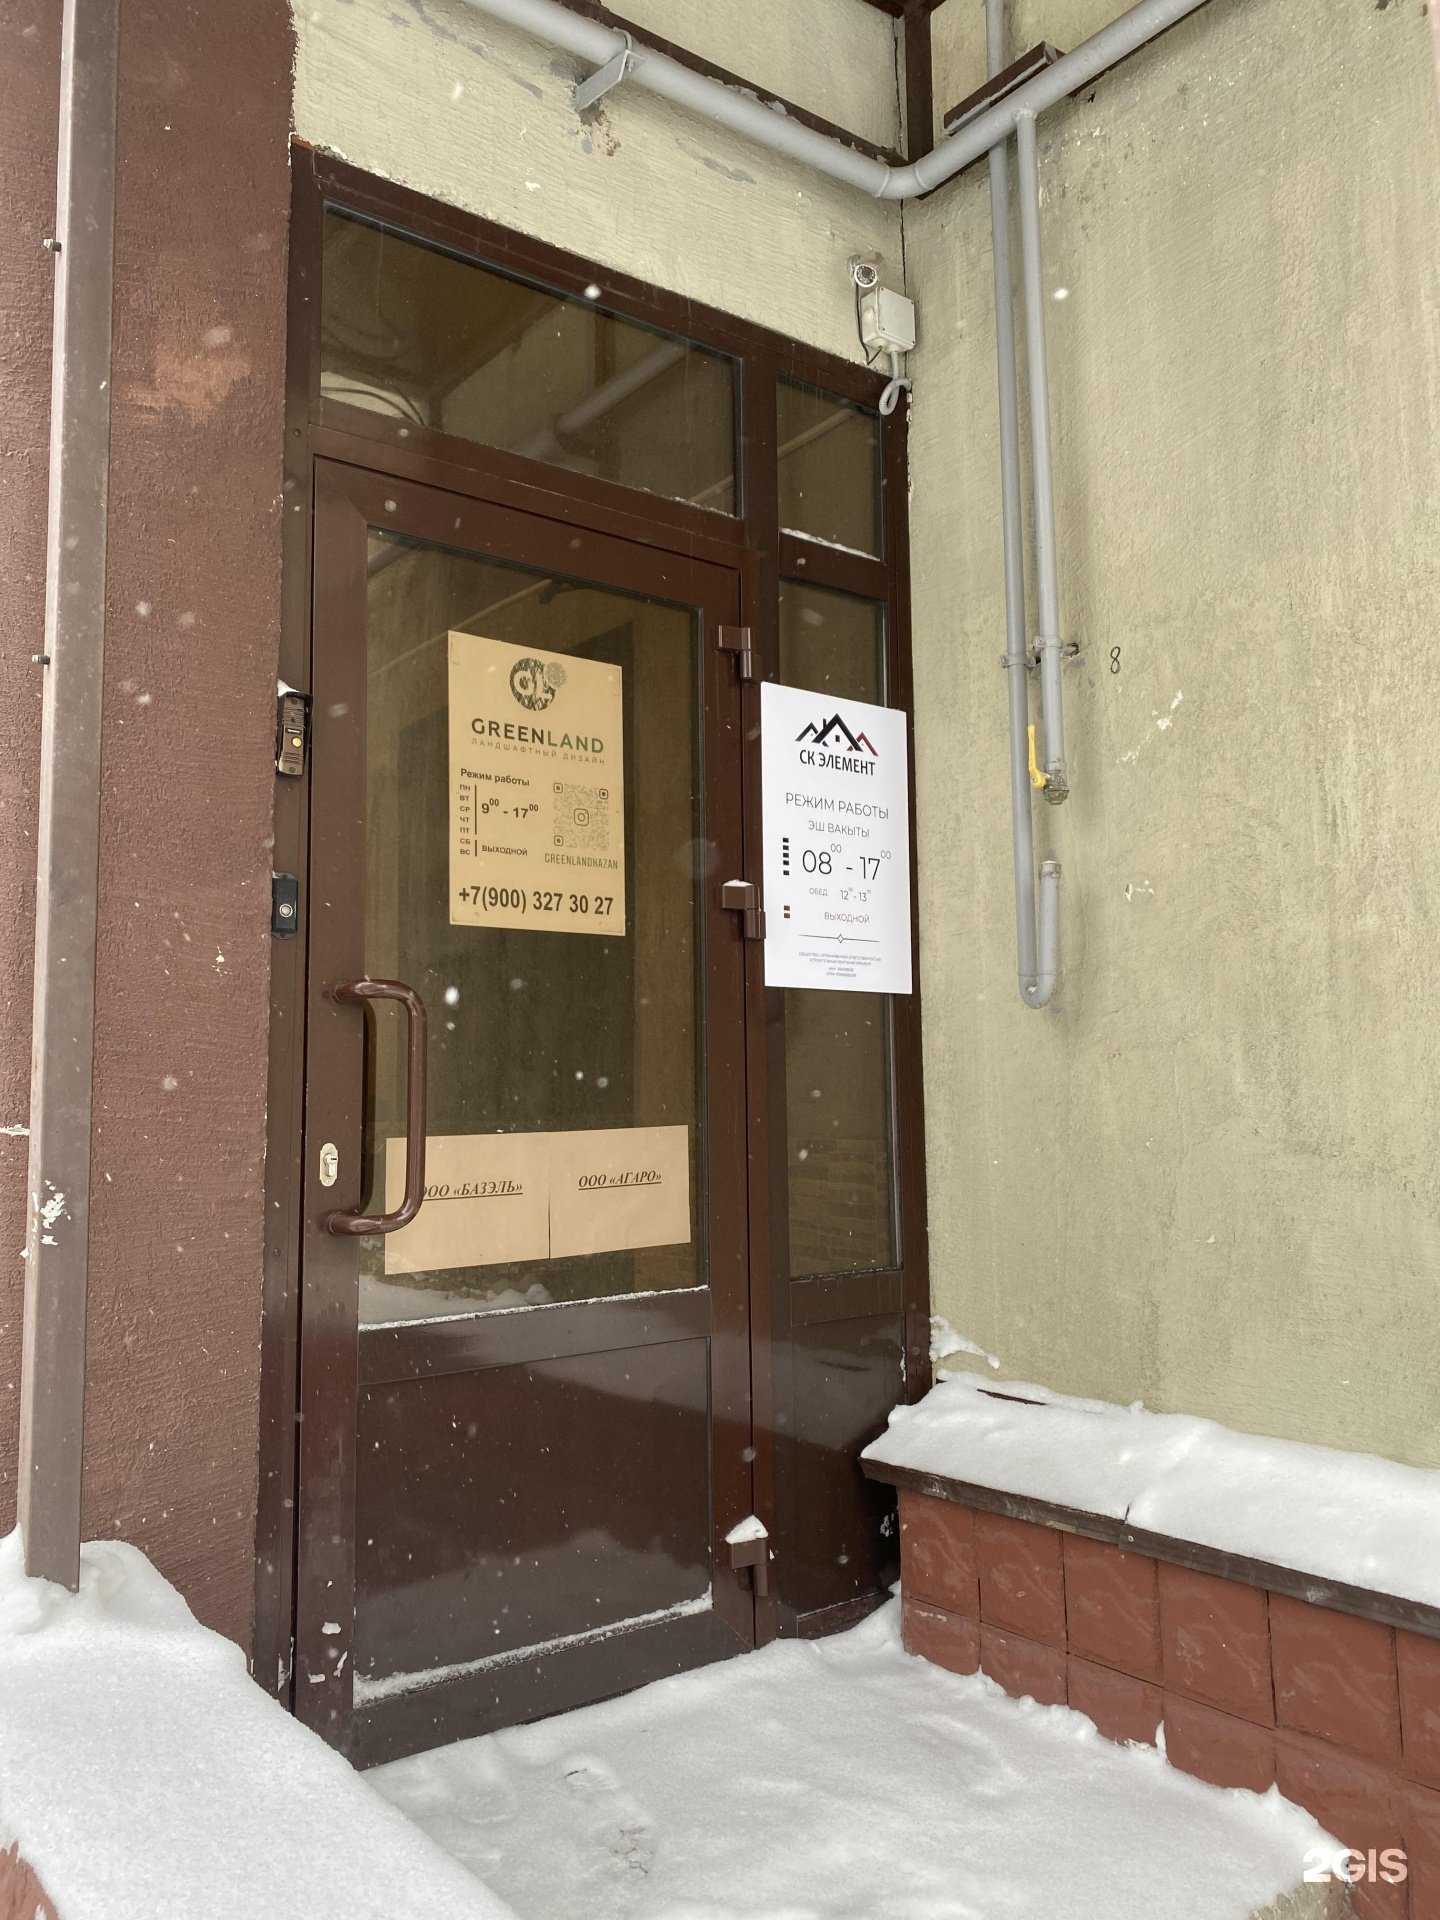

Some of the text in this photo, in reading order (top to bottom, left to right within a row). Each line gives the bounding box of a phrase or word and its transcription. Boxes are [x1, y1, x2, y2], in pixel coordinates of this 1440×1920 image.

[1109, 646, 1122, 675] 8
[471, 717, 604, 754] GREENLAND
[471, 737, 606, 765] ЛАНДШАФТНЫЙ ДИЗАЙН
[799, 749, 876, 777] СК ЭЛЕМЕНТ
[460, 767, 530, 787] Режим работы
[786, 791, 889, 820] РЕЖИМ РАБОТЫ
[808, 820, 870, 838] ЭШ ВАКЫТЫ
[544, 852, 619, 870] GREENLANDKAZAN
[459, 885, 614, 916] +7(900) 327 30 27
[824, 911, 871, 925] ВЫХОДНОЙ
[453, 1180, 523, 1196] «БАЗЭЛЬ»
[578, 1169, 662, 1188] ООО «АГАРО»
